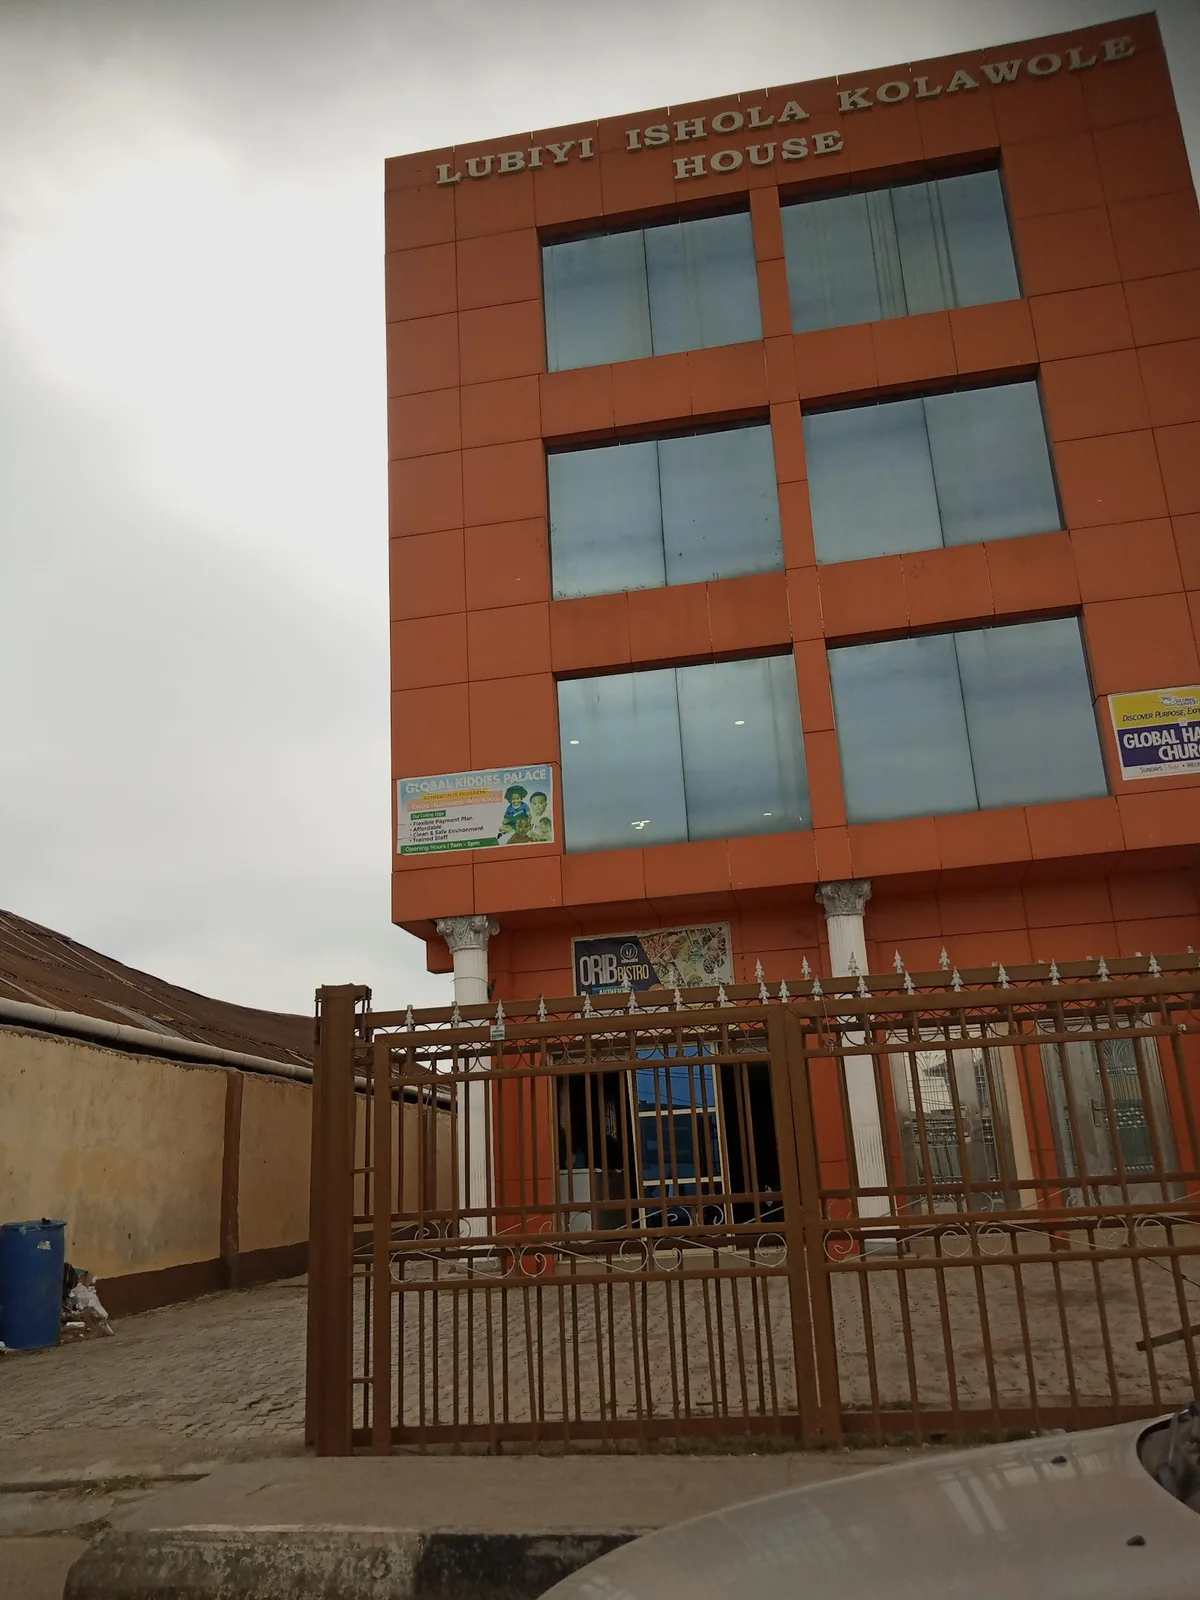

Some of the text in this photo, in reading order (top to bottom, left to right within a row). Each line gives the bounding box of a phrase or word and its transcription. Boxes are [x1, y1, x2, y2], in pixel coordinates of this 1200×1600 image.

[436, 36, 1136, 185] LUBIYI ISHOLA KOLAWOLE
[674, 130, 844, 180] HOUSE
[1123, 712, 1153, 721] DISCOVER
[1123, 729, 1179, 749] GLOBAL
[1159, 743, 1200, 761] CHUR
[406, 769, 546, 794] GLOBAL KIDDIES PALACE
[423, 793, 451, 801] ADMISSION
[413, 824, 442, 832] Affordable
[435, 817, 460, 825] Payment
[448, 826, 484, 834] Environment
[405, 844, 429, 853] Opening
[467, 841, 480, 849] 5pm
[617, 964, 650, 982] BISTRO
